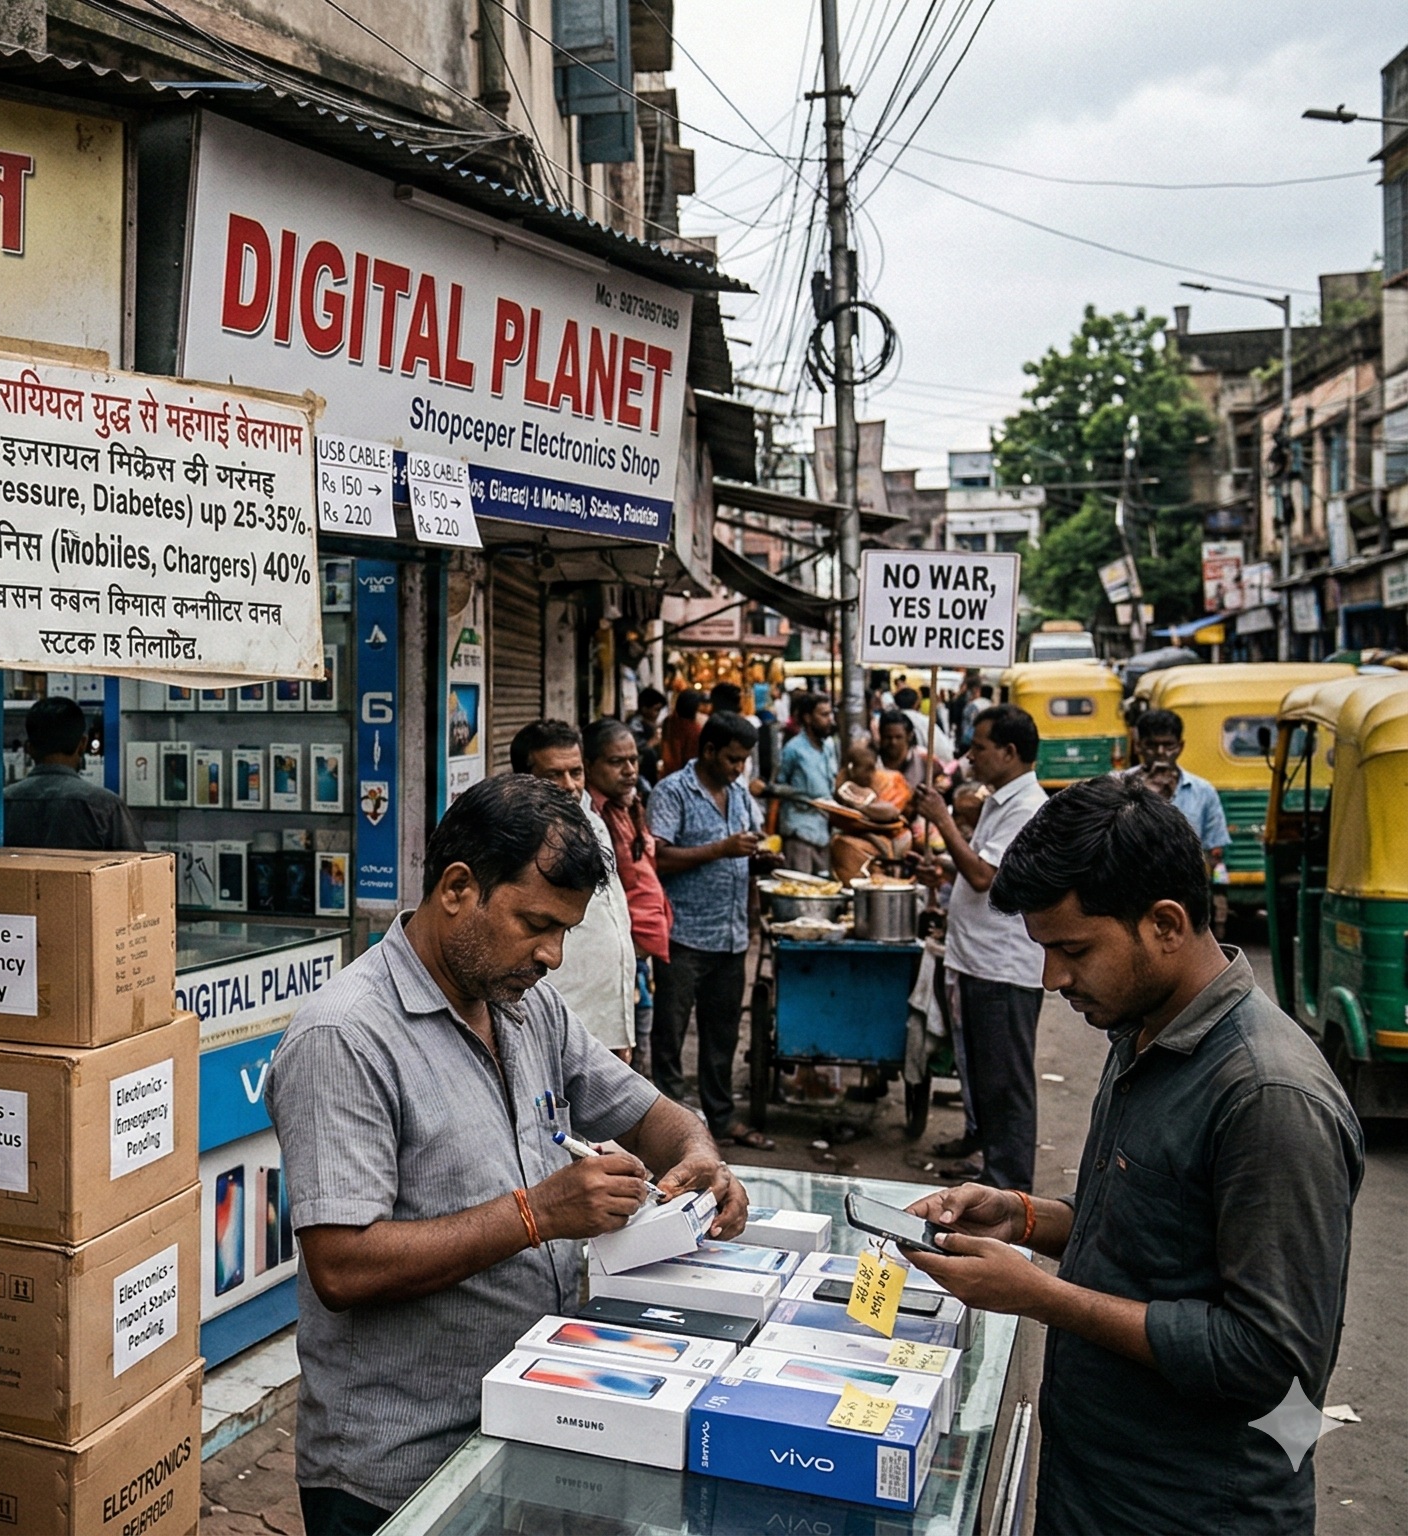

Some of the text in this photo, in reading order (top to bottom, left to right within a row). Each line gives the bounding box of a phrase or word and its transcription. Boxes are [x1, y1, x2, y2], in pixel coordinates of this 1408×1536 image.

[221, 211, 673, 436] DIGITAL PLANET
[90, 387, 304, 456] युद्ध से महंगाई बेलगाम
[409, 393, 660, 485] Shopceper Electronics Shop
[319, 439, 392, 471] USB CABLE:
[321, 471, 363, 497] Rs 150
[408, 457, 432, 479] USB
[433, 462, 468, 485] CABLE:
[93, 483, 193, 529] Diabetes)
[200, 502, 227, 532] up
[233, 500, 312, 535] 25-35%.
[323, 500, 372, 526] Rs 220
[413, 486, 426, 507] Rs
[429, 490, 448, 510] 150
[417, 514, 460, 537] Rs 220
[163, 544, 311, 586] Chargers) 40%
[883, 563, 996, 599] NO WAR,
[888, 596, 988, 621] YES LOW
[869, 624, 1005, 651] LOW PRICES
[261, 954, 335, 1006] PLANET
[556, 1415, 605, 1431] SAMSUNG
[769, 1448, 835, 1473] vivo
[103, 1436, 192, 1524] ELECTRONICS
